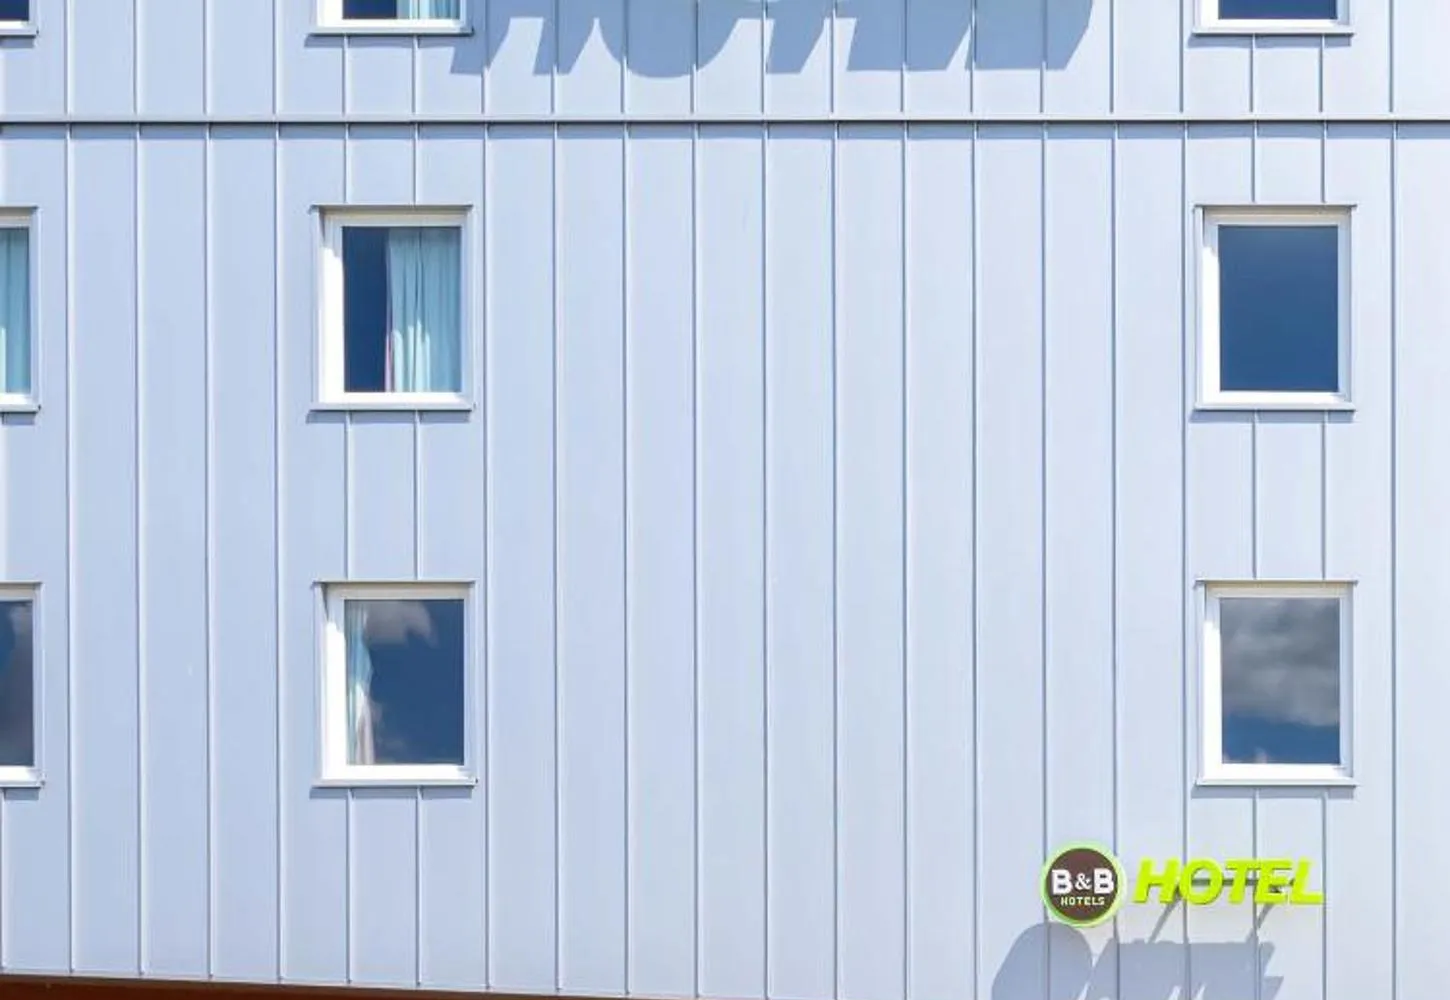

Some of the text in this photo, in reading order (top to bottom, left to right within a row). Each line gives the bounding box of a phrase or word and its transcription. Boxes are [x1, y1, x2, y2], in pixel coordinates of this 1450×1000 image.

[1051, 868, 1115, 895] B&B
[1133, 858, 1325, 905] HOTEL
[1060, 896, 1105, 906] HOTELS
